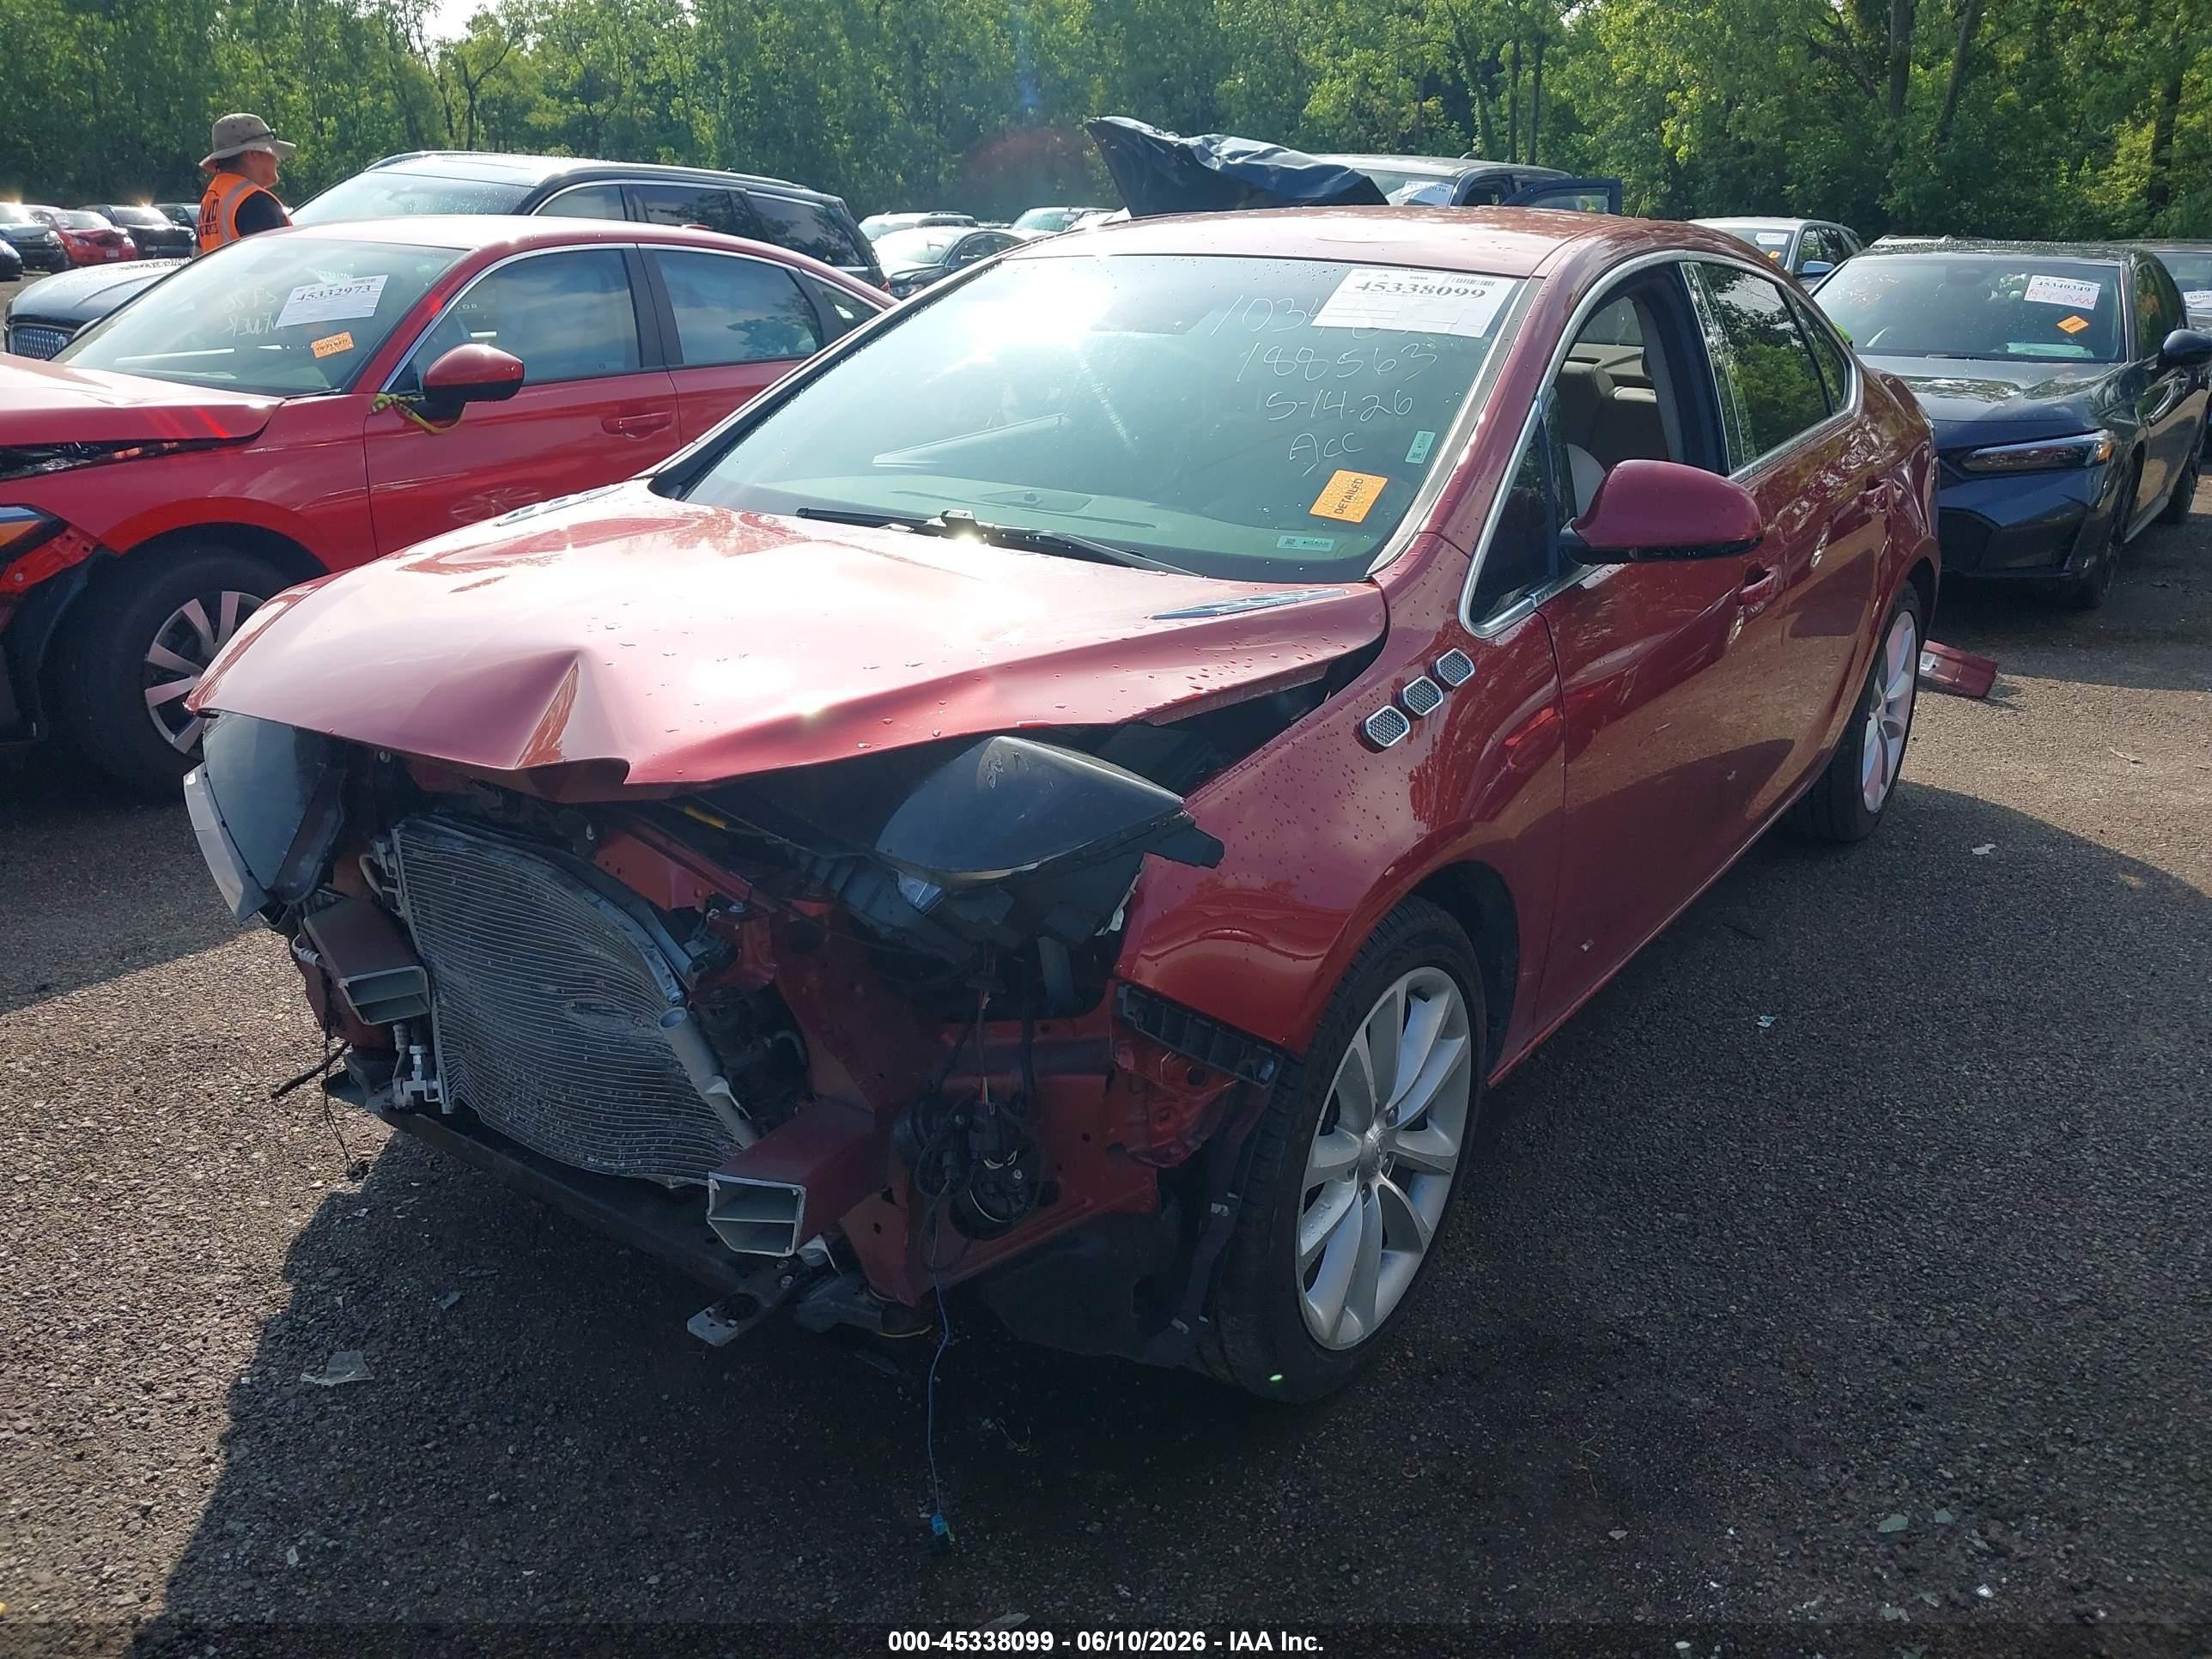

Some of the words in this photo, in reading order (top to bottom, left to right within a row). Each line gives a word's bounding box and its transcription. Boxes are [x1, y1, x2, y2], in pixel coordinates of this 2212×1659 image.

[1354, 280, 1486, 300] 45338099
[1236, 342, 1438, 383] 188563
[1334, 477, 1364, 515] DETAILED
